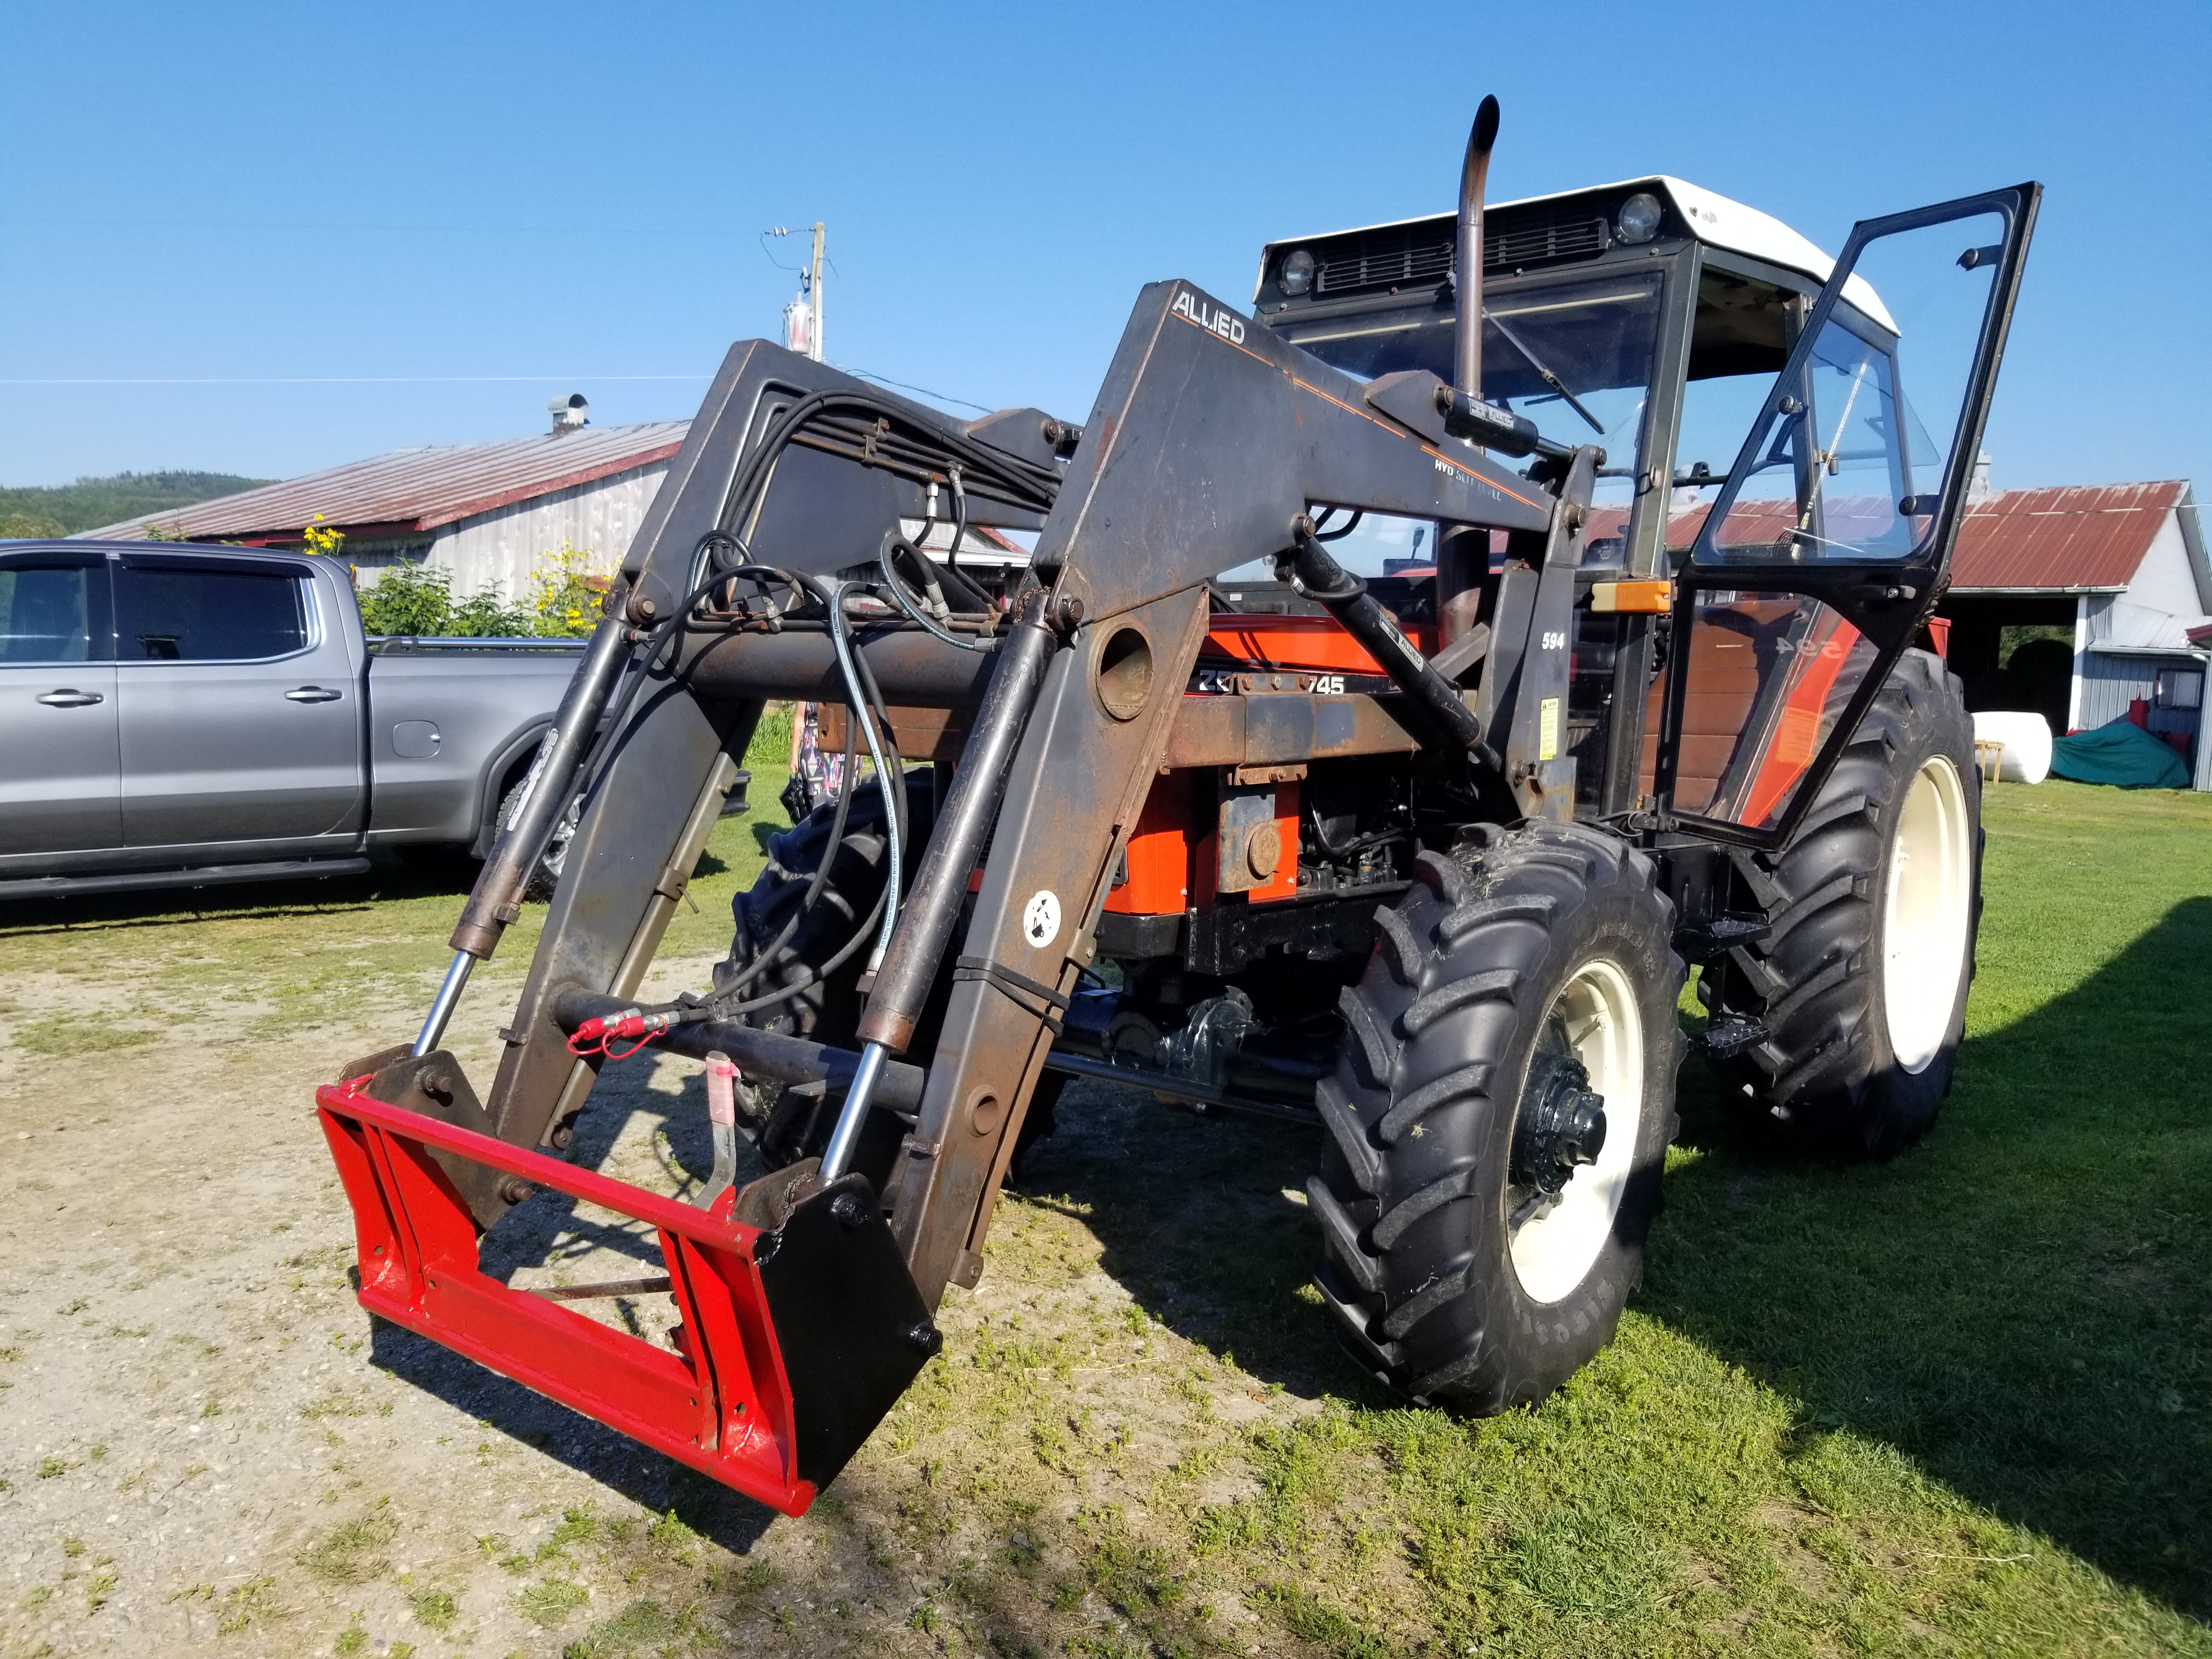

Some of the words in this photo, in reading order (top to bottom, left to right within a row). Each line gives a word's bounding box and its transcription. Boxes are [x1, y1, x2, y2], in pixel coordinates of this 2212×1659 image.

[1172, 291, 1245, 345] ALLIED
[1435, 459, 1453, 476] HYD
[1401, 639, 1421, 665] ALLIED
[1542, 632, 1565, 650] 594
